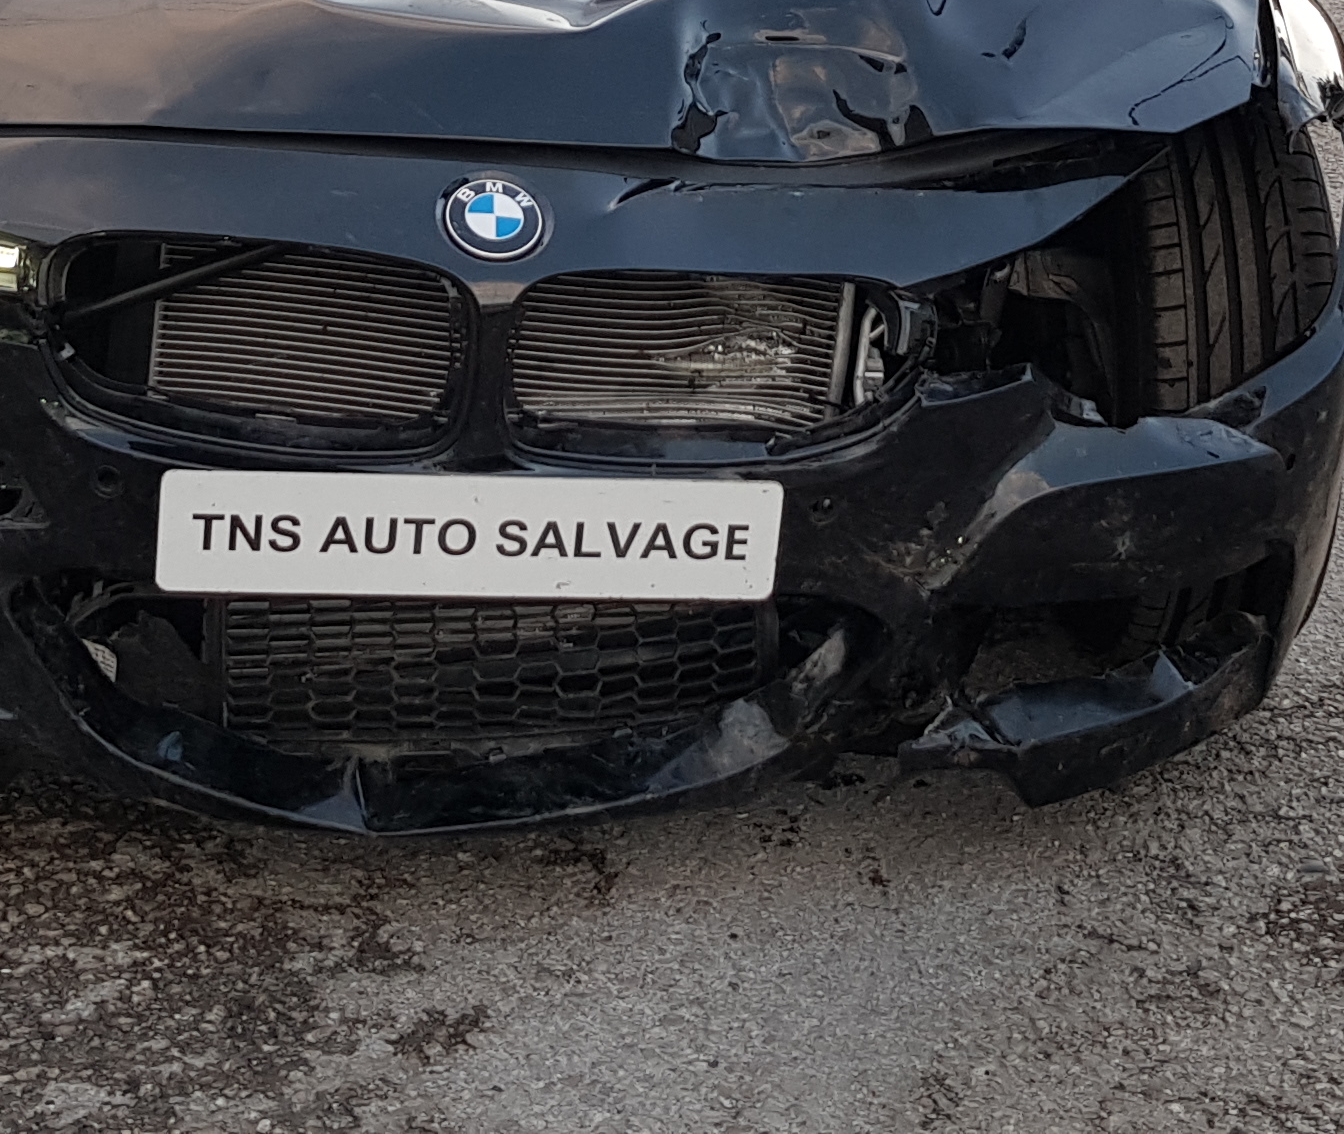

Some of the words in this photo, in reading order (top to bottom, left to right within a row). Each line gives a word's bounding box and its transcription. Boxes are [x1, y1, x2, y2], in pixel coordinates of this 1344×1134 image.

[457, 181, 534, 207] BMW
[192, 513, 302, 553] TNS
[319, 516, 478, 557] AUTO
[494, 520, 751, 562] SALVAGE
